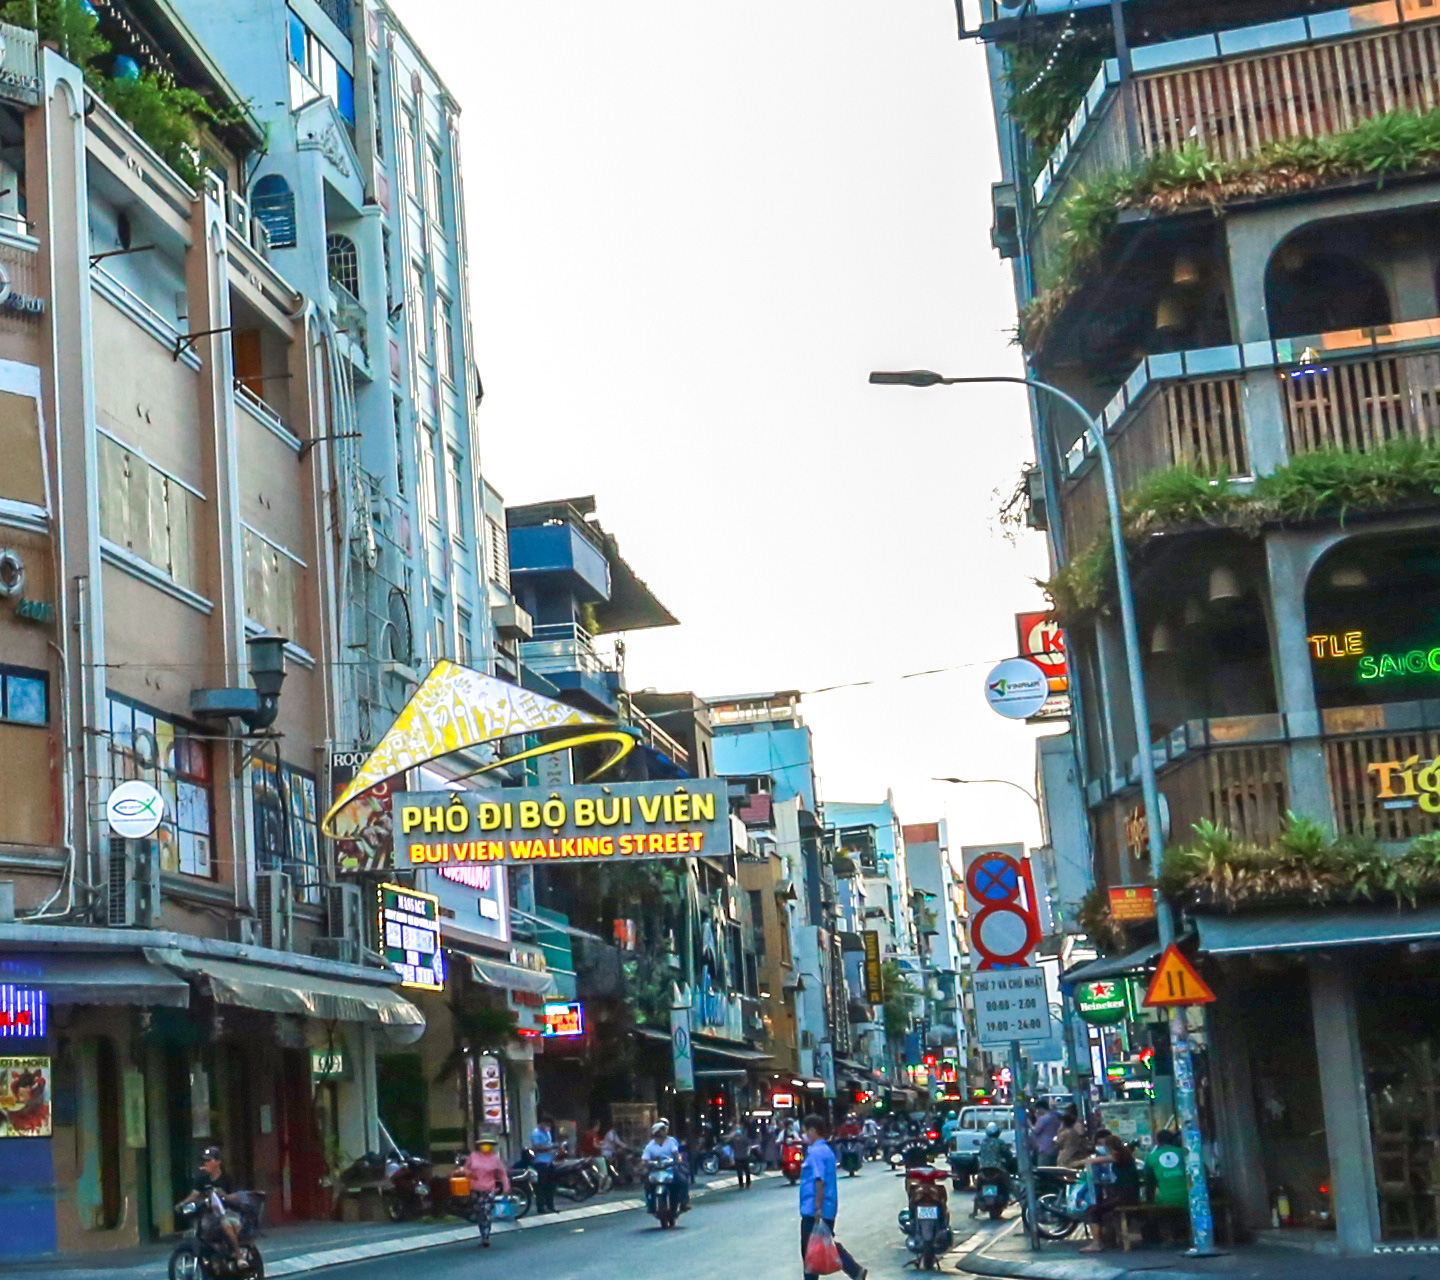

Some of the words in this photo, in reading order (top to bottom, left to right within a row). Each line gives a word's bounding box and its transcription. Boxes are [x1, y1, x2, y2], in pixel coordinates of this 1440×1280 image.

[401, 792, 470, 834] PHỐ
[477, 803, 513, 831] ĐI
[520, 792, 566, 836] BỘ
[574, 787, 632, 829] BÙI
[410, 842, 450, 863] BUI
[452, 840, 505, 862] VIEN
[510, 836, 614, 860] WALKING
[618, 831, 705, 856] STREET
[1080, 998, 1125, 1012] Heineken
